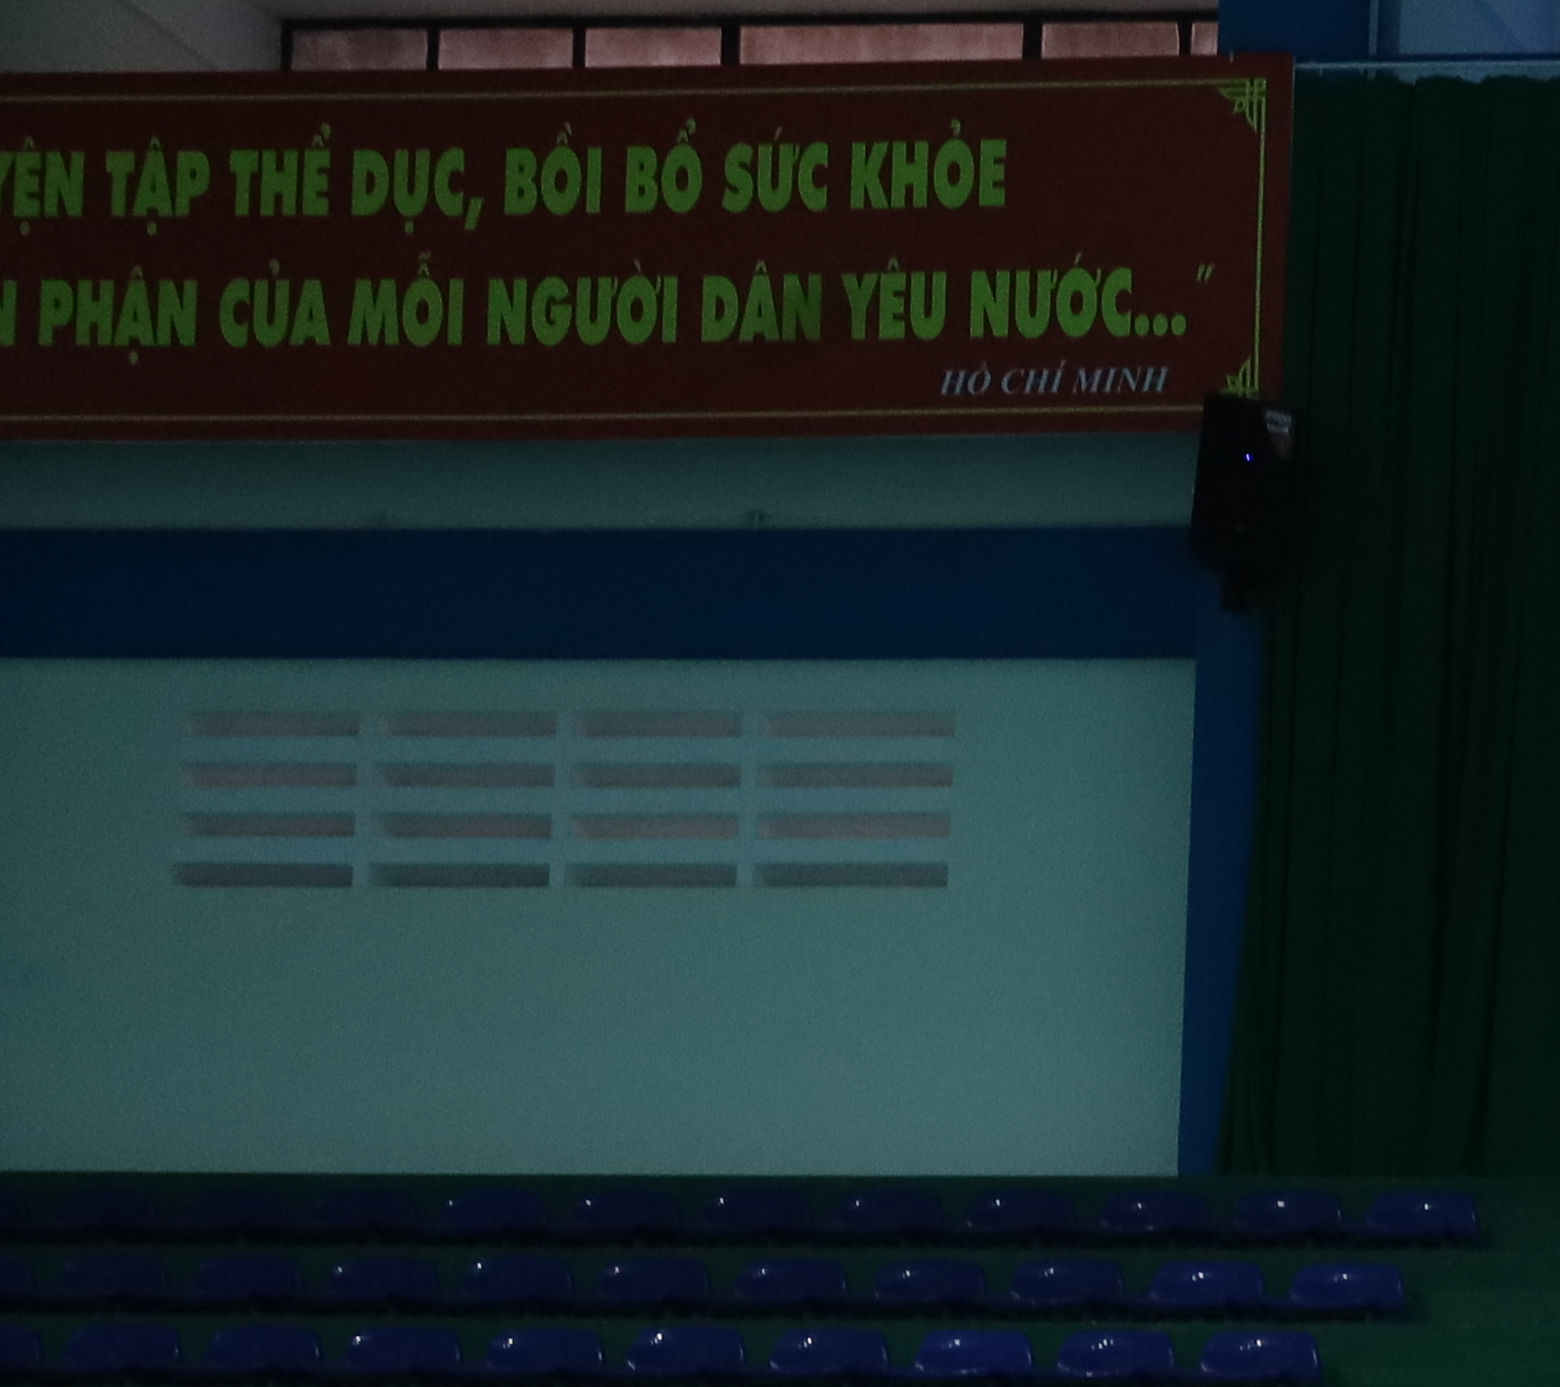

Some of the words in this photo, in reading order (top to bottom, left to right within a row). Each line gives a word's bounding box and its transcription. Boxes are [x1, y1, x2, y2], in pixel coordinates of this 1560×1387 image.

[104, 135, 212, 237] TẬP
[228, 122, 332, 218] THỂ
[350, 145, 485, 236] DỤC,
[502, 121, 604, 217] BỒI
[623, 116, 705, 215] BỔ
[720, 126, 830, 215] SỨC
[848, 117, 1009, 211] KHỎE
[37, 265, 199, 366] PHẬN
[217, 259, 332, 349] CỦA
[346, 251, 466, 348] MỖI
[485, 258, 680, 348] NGƯỜI
[699, 258, 824, 347] DÂN
[840, 256, 948, 342] YÊU
[1000, 358, 1068, 396] CHÍ
[1071, 365, 1170, 395] MINH
